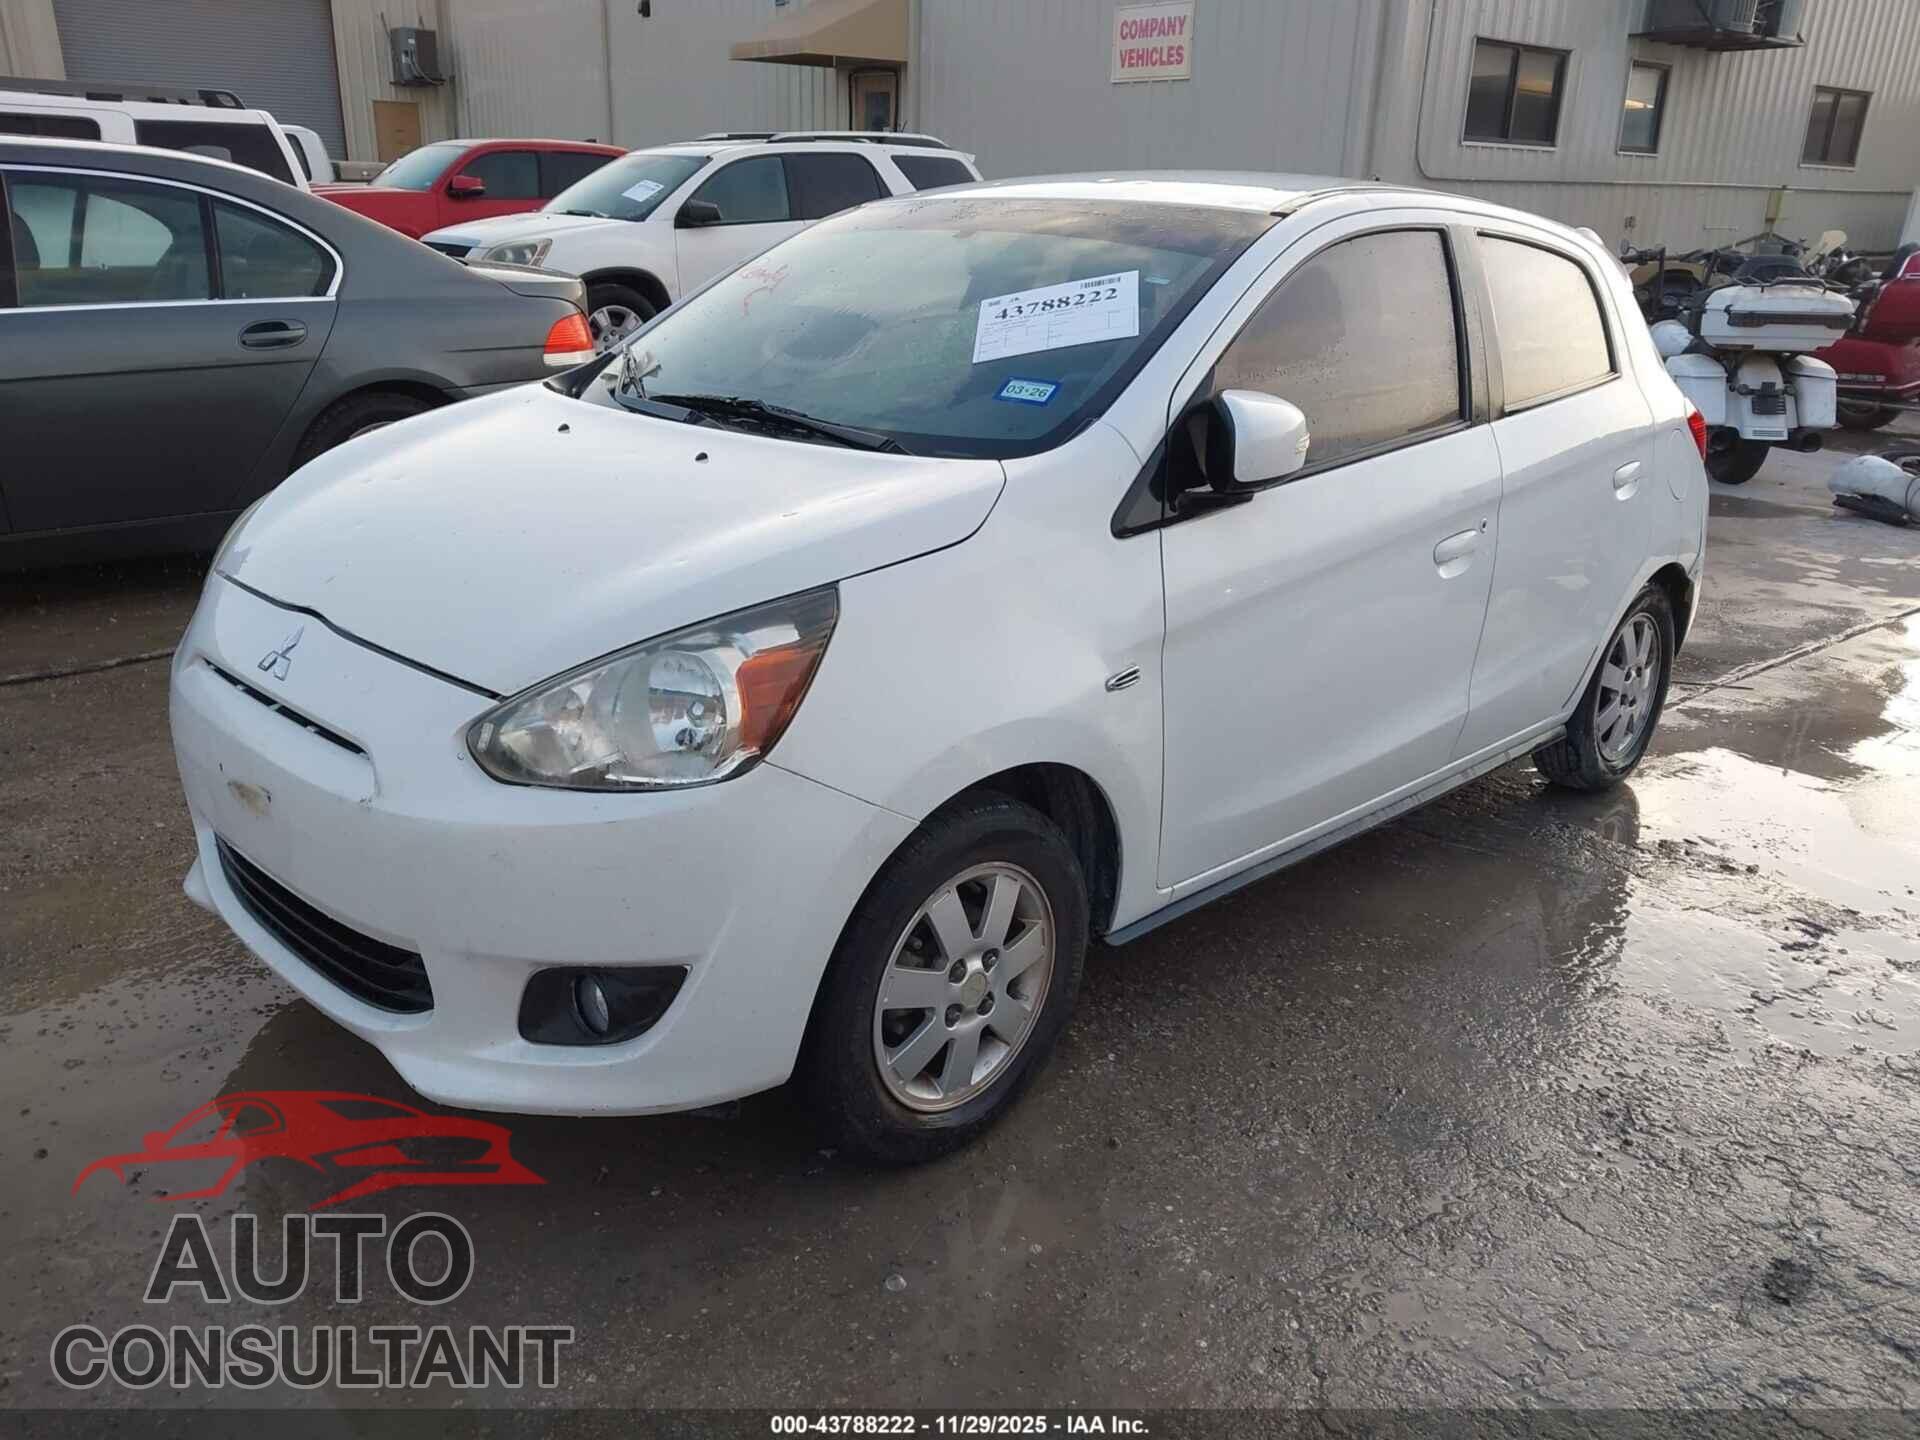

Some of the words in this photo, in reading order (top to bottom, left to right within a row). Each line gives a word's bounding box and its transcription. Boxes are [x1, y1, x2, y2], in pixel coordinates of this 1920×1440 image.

[1120, 15, 1185, 40] COMPANY
[1120, 45, 1184, 68] VEHICLES
[994, 287, 1118, 320] 43788222
